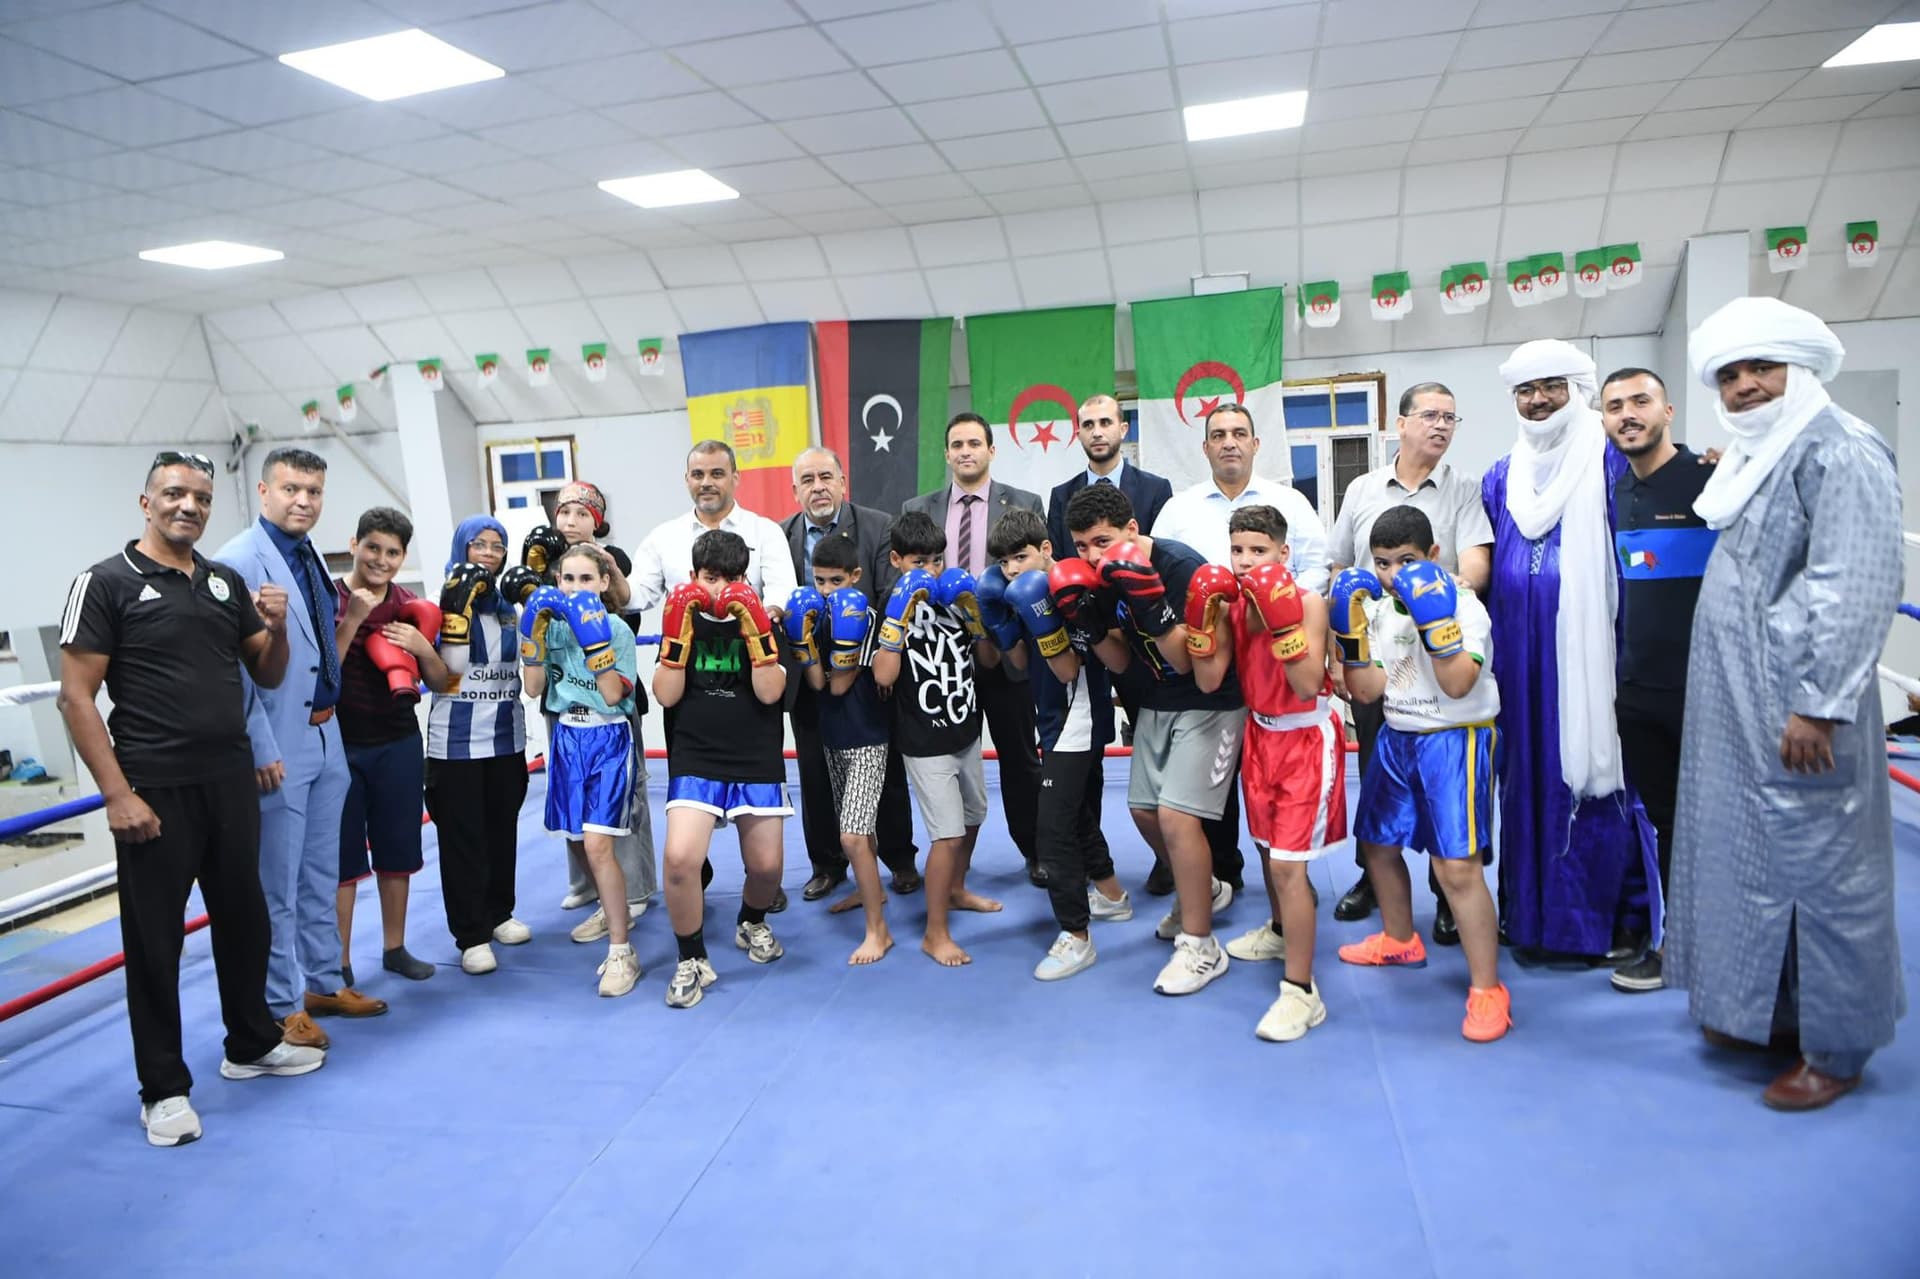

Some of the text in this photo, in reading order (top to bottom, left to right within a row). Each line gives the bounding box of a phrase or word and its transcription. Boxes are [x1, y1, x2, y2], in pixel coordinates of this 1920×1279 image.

[1040, 632, 1065, 650] EVERLAST
[1281, 641, 1305, 656] PETRA
[594, 658, 614, 671] PETRA
